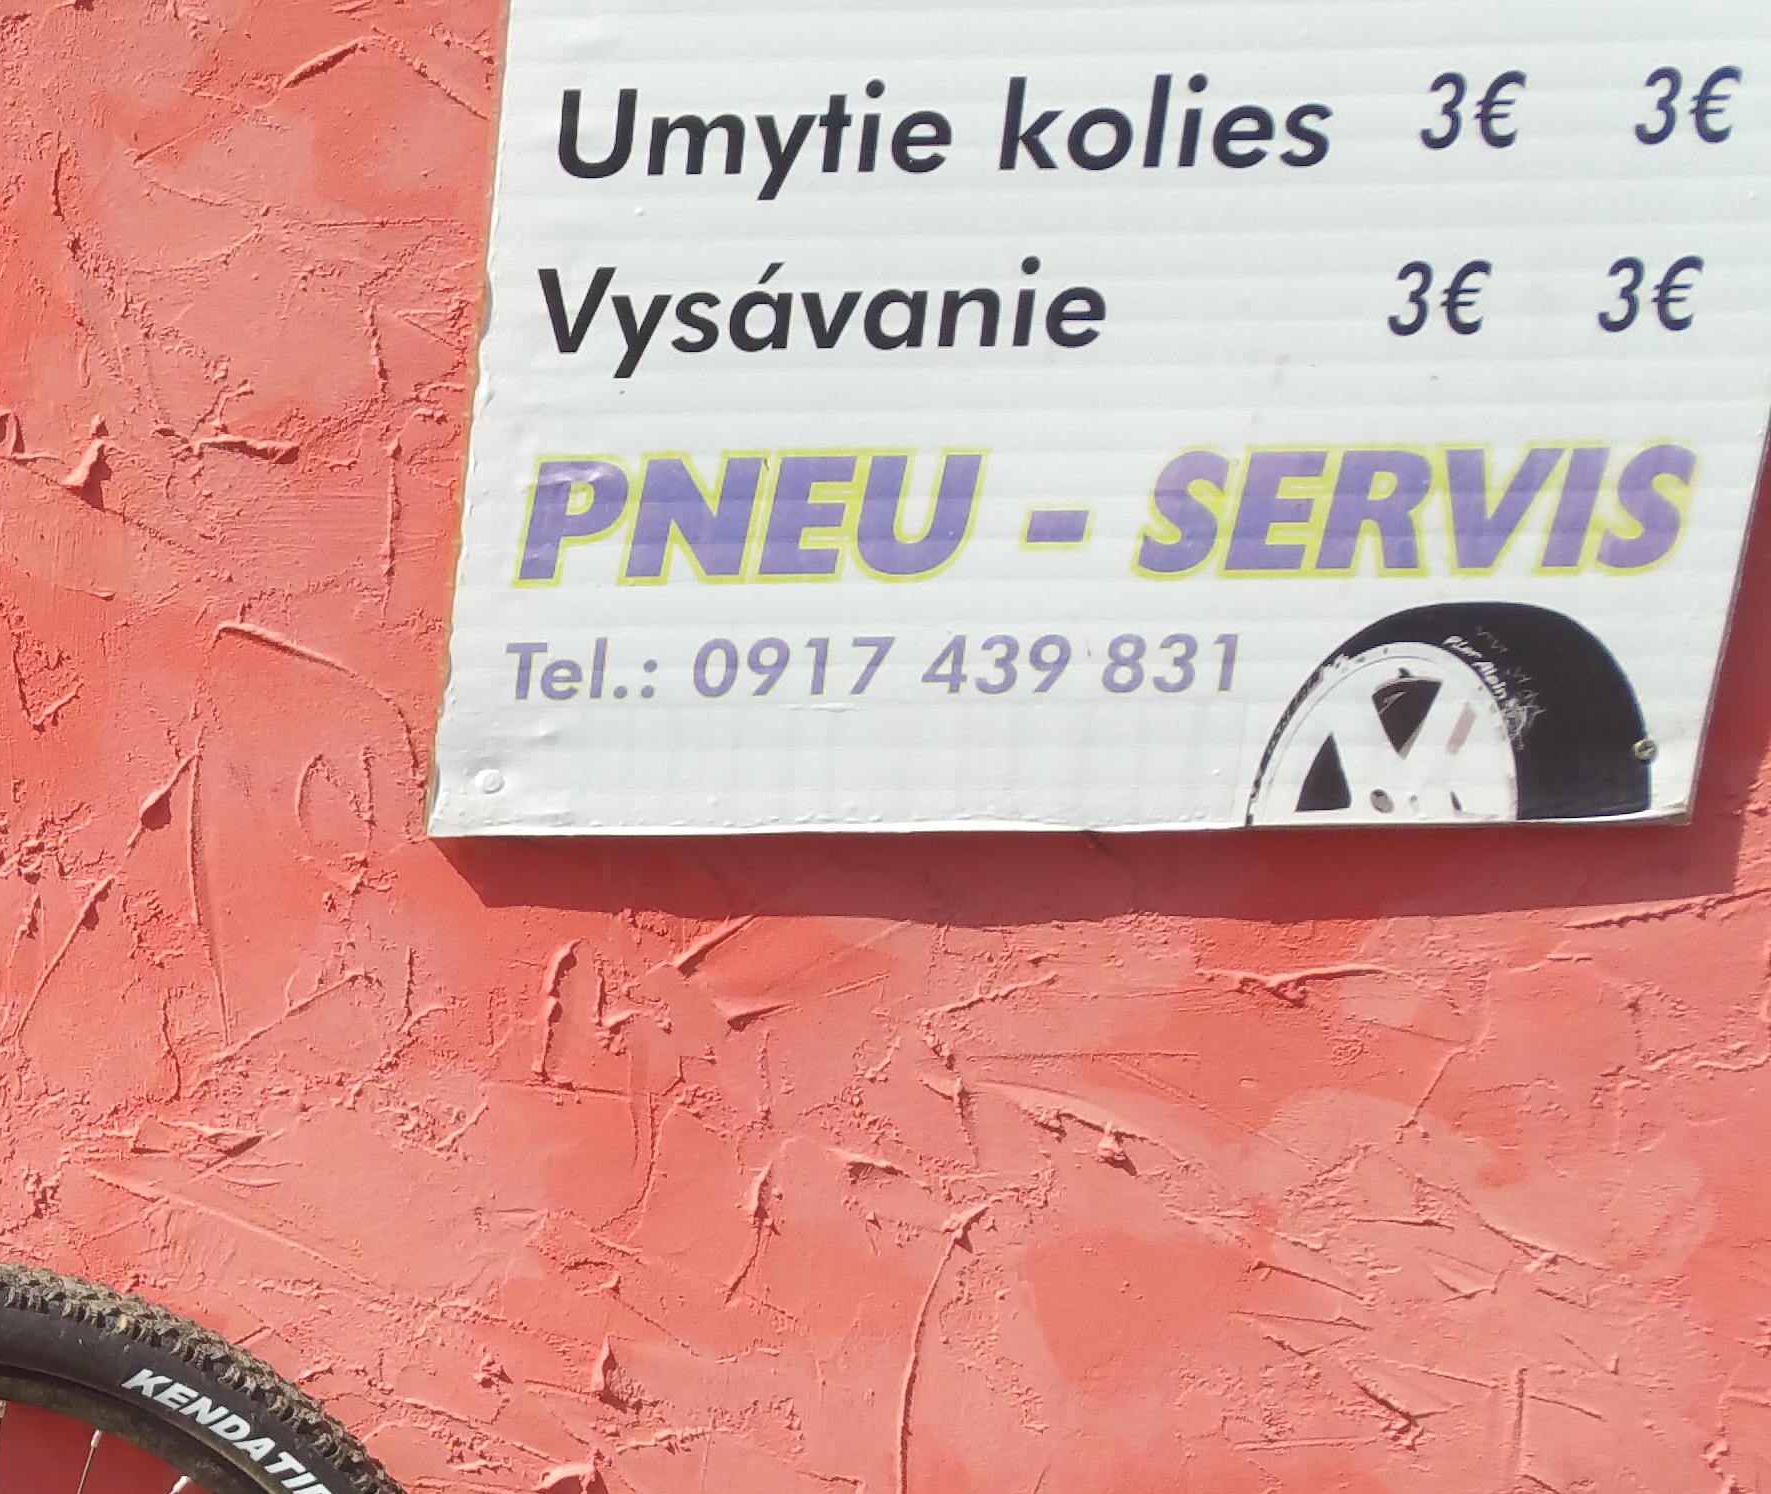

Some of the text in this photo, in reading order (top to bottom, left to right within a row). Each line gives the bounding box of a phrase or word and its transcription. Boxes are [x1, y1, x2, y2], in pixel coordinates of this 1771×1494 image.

[556, 65, 1742, 202] Umytie kolies 3€ 3€
[536, 255, 1705, 380] Vysávanie 3€ 3€
[511, 446, 990, 589] PNEU
[1130, 441, 1699, 582] SERVIS
[506, 632, 1240, 702] Tel.: 0917 439 831
